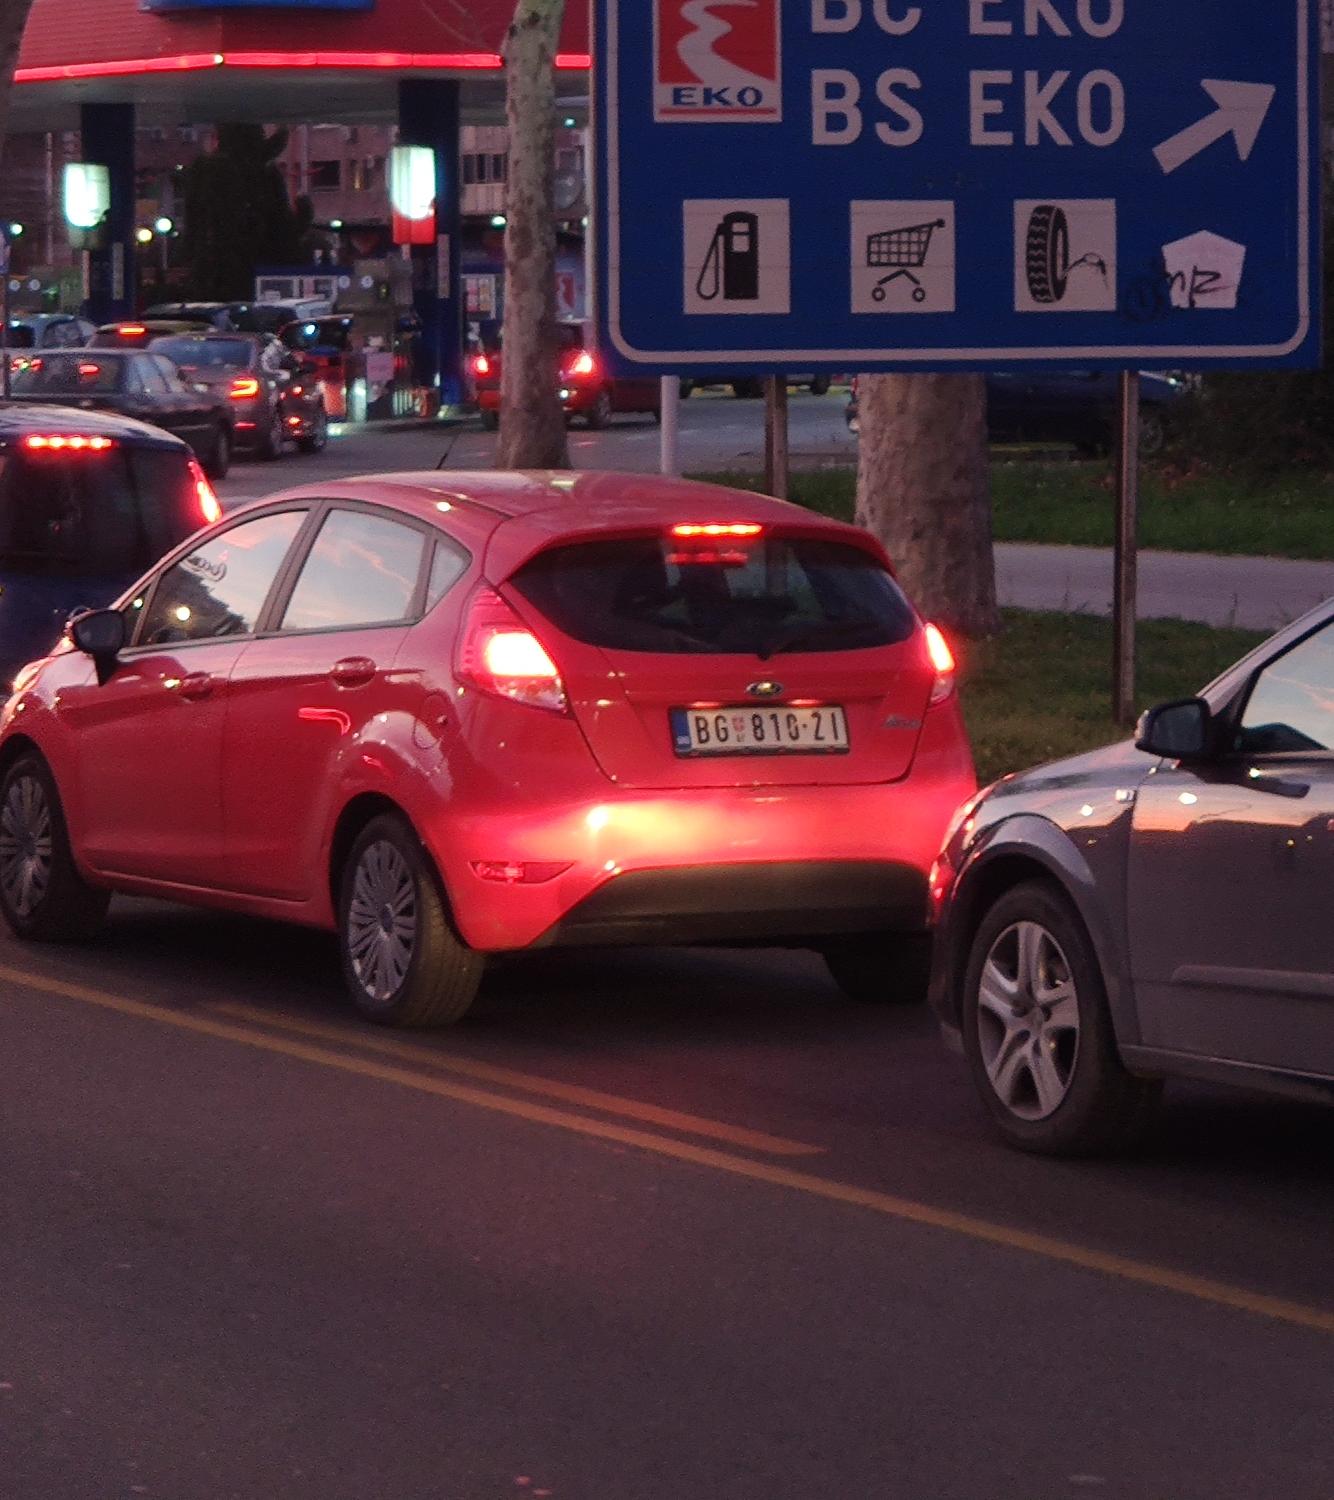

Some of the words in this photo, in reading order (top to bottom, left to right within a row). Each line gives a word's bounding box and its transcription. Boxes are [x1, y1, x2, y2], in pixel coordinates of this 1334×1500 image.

[672, 86, 764, 107] EKO
[810, 67, 924, 149] BS
[968, 68, 1126, 149] EKO
[695, 715, 729, 744] BG
